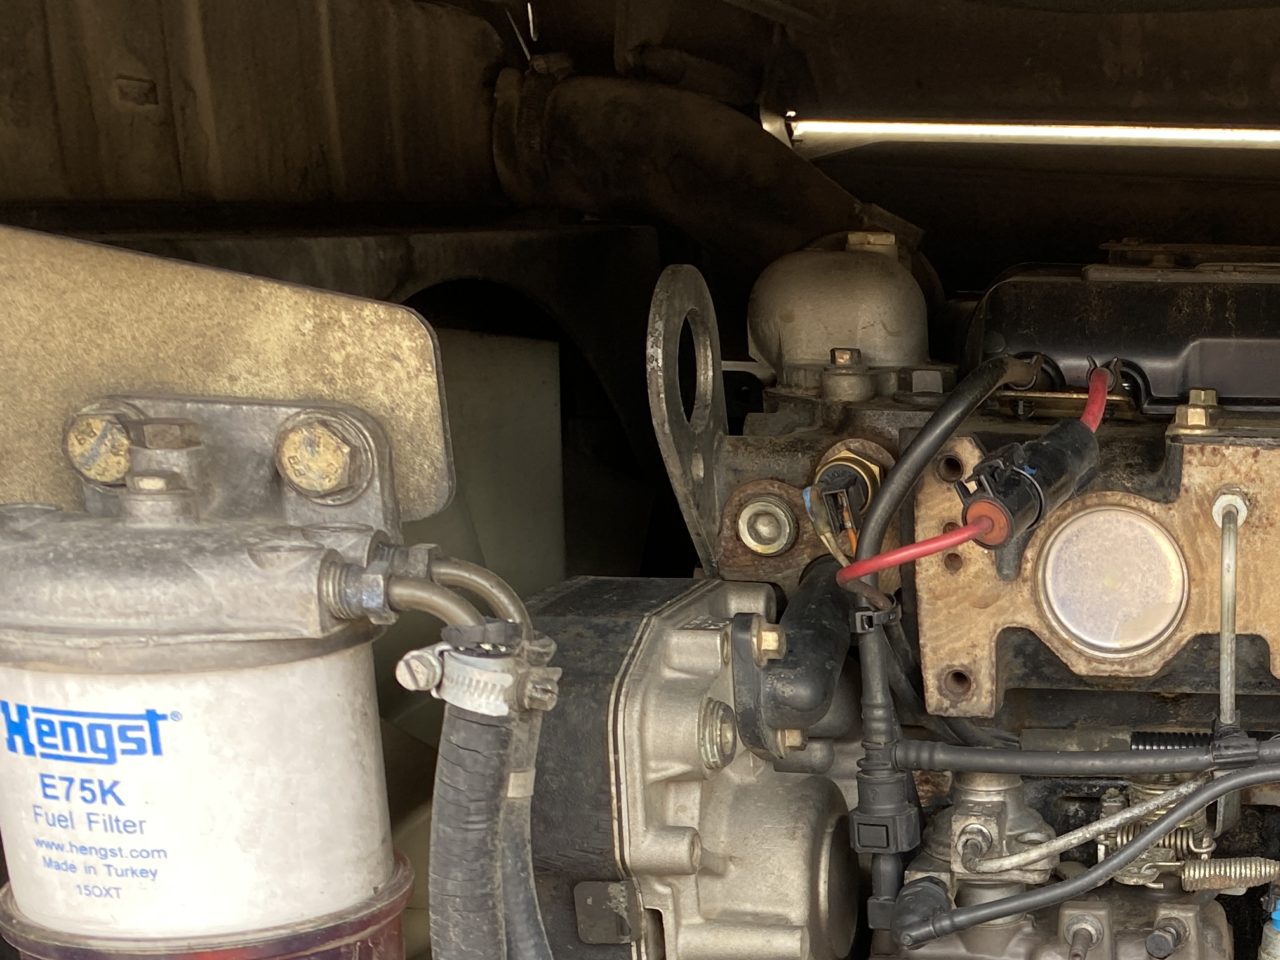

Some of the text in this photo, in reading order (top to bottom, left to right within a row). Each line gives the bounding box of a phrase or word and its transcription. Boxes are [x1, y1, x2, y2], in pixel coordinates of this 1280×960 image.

[0, 699, 168, 766] Hengst
[38, 773, 126, 807] E75K
[32, 804, 147, 836] Fuel Filter
[33, 836, 169, 862] www.hengst.com
[42, 855, 159, 882] Made in Turkey
